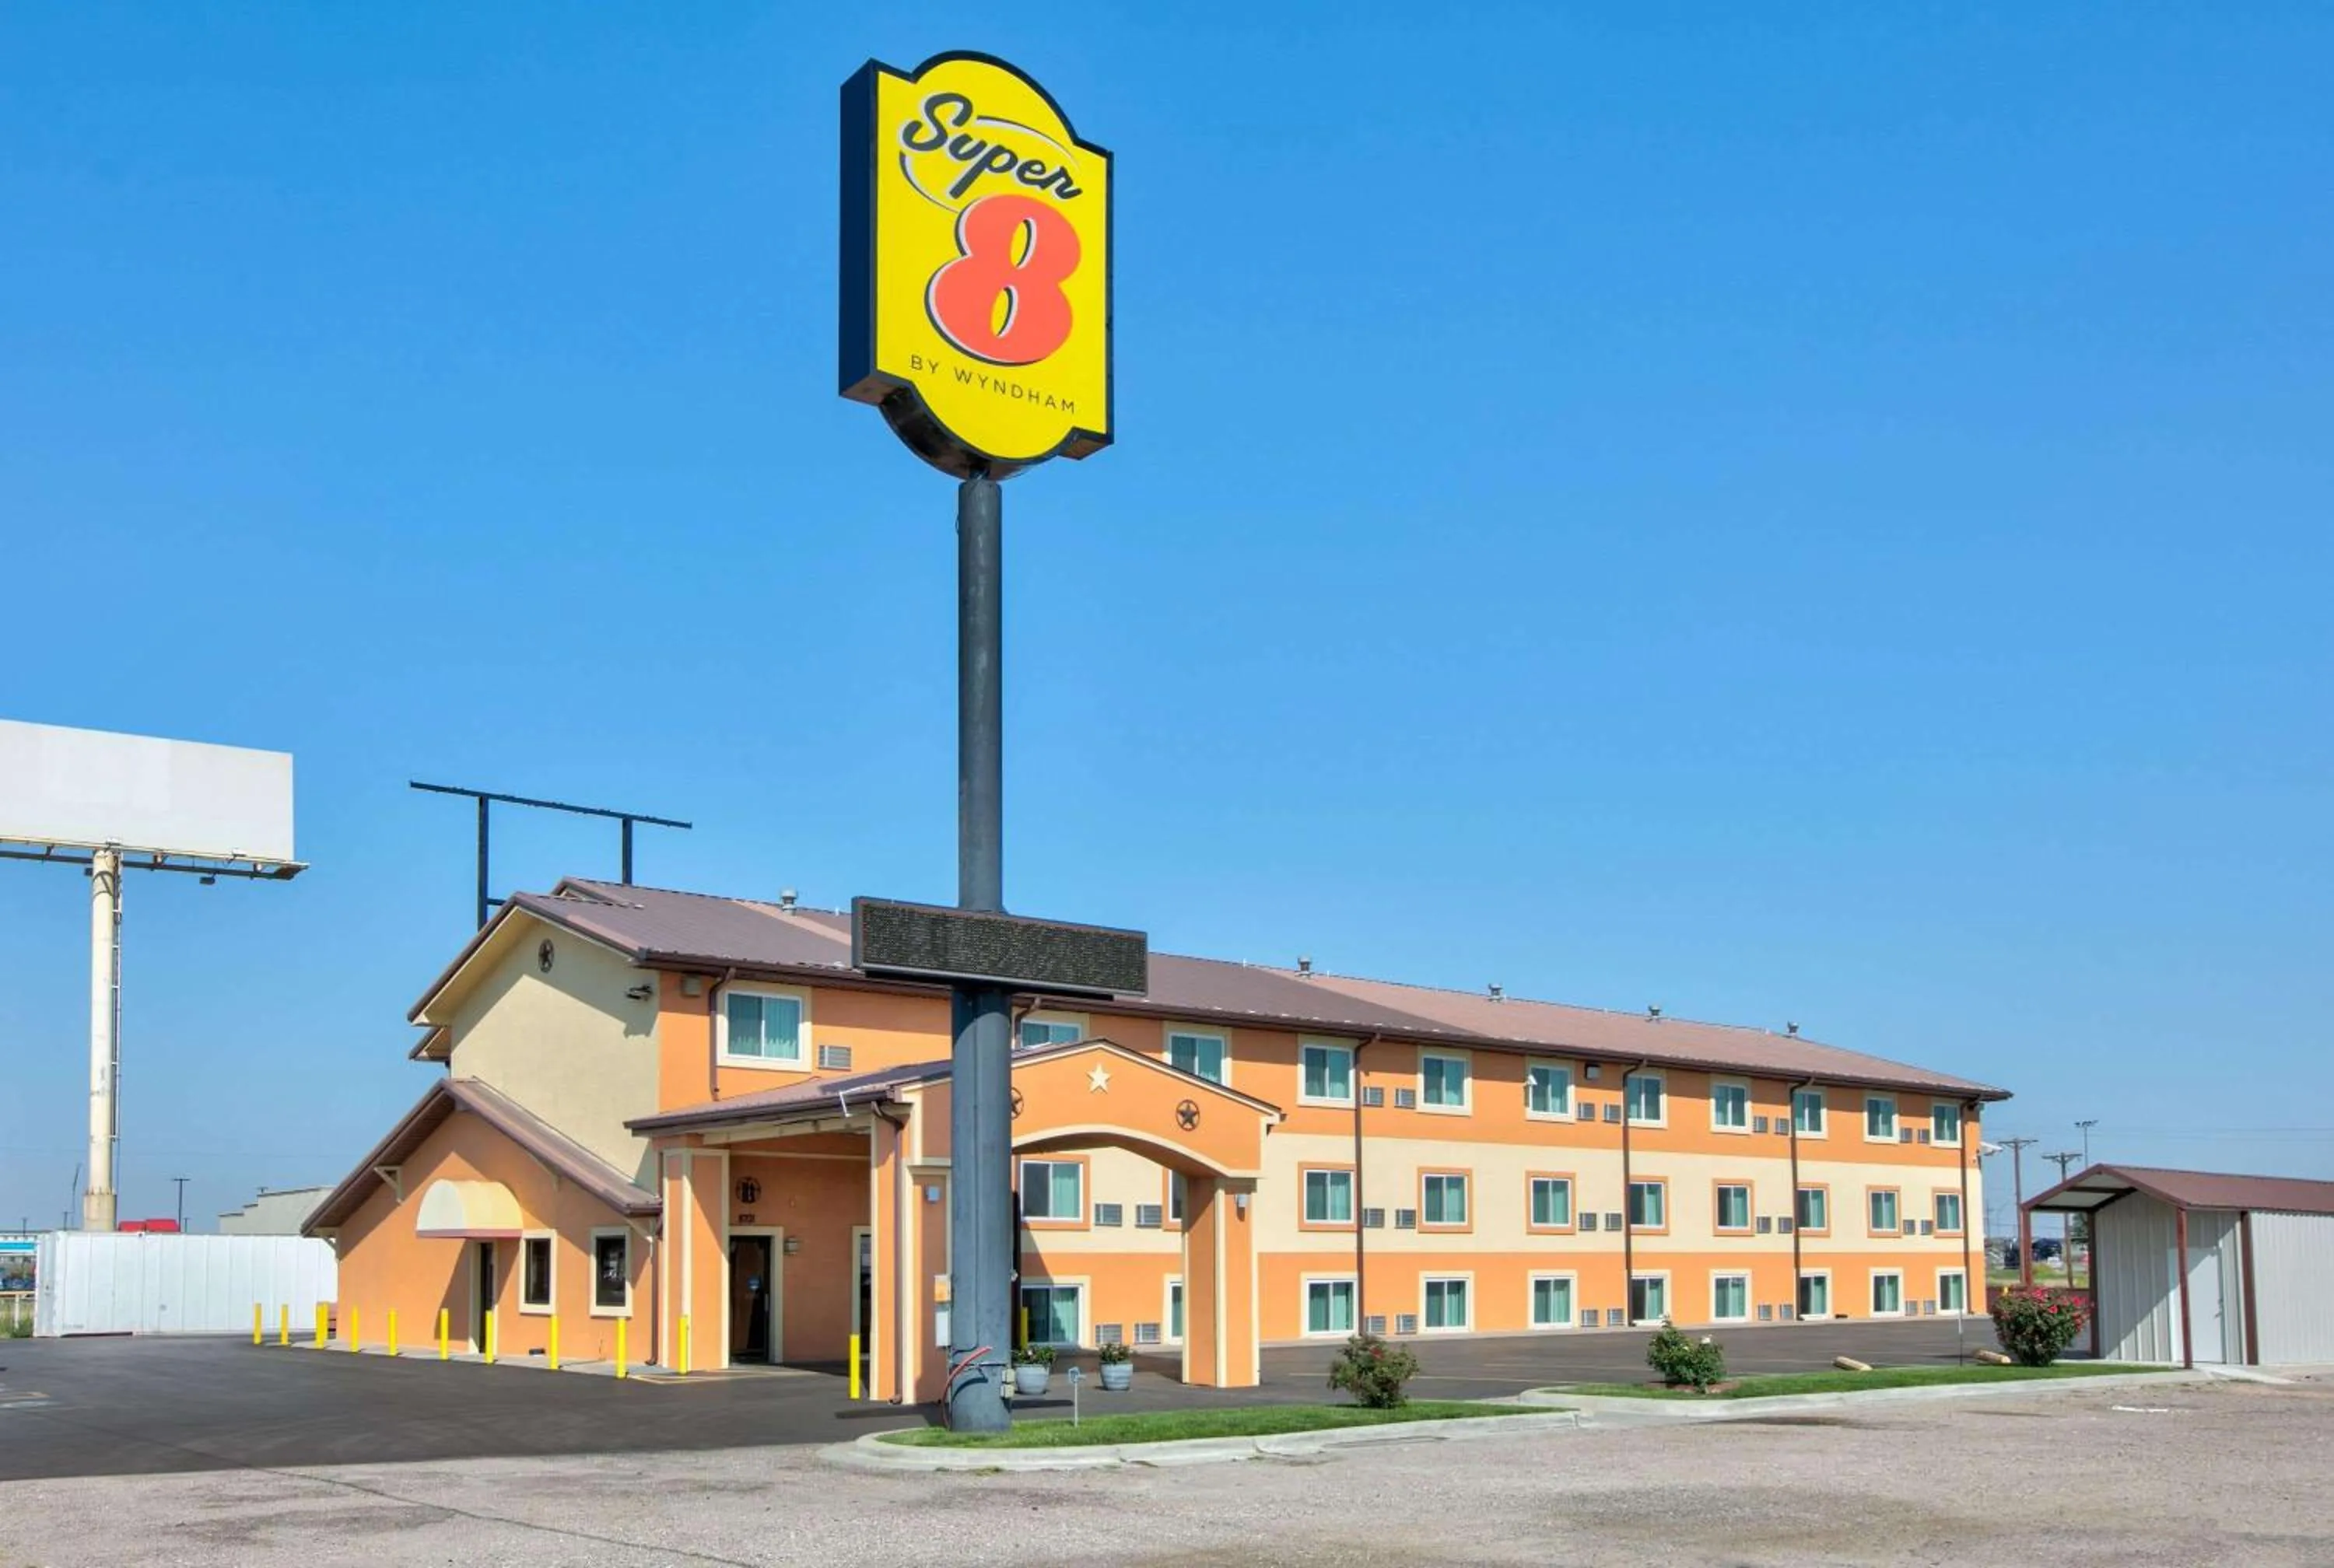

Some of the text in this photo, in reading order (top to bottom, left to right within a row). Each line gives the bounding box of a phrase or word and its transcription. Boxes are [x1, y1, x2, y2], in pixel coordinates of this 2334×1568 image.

[901, 92, 1083, 200] Super
[924, 193, 1081, 366] 8
[911, 355, 1075, 414] BY WYNDHAM
